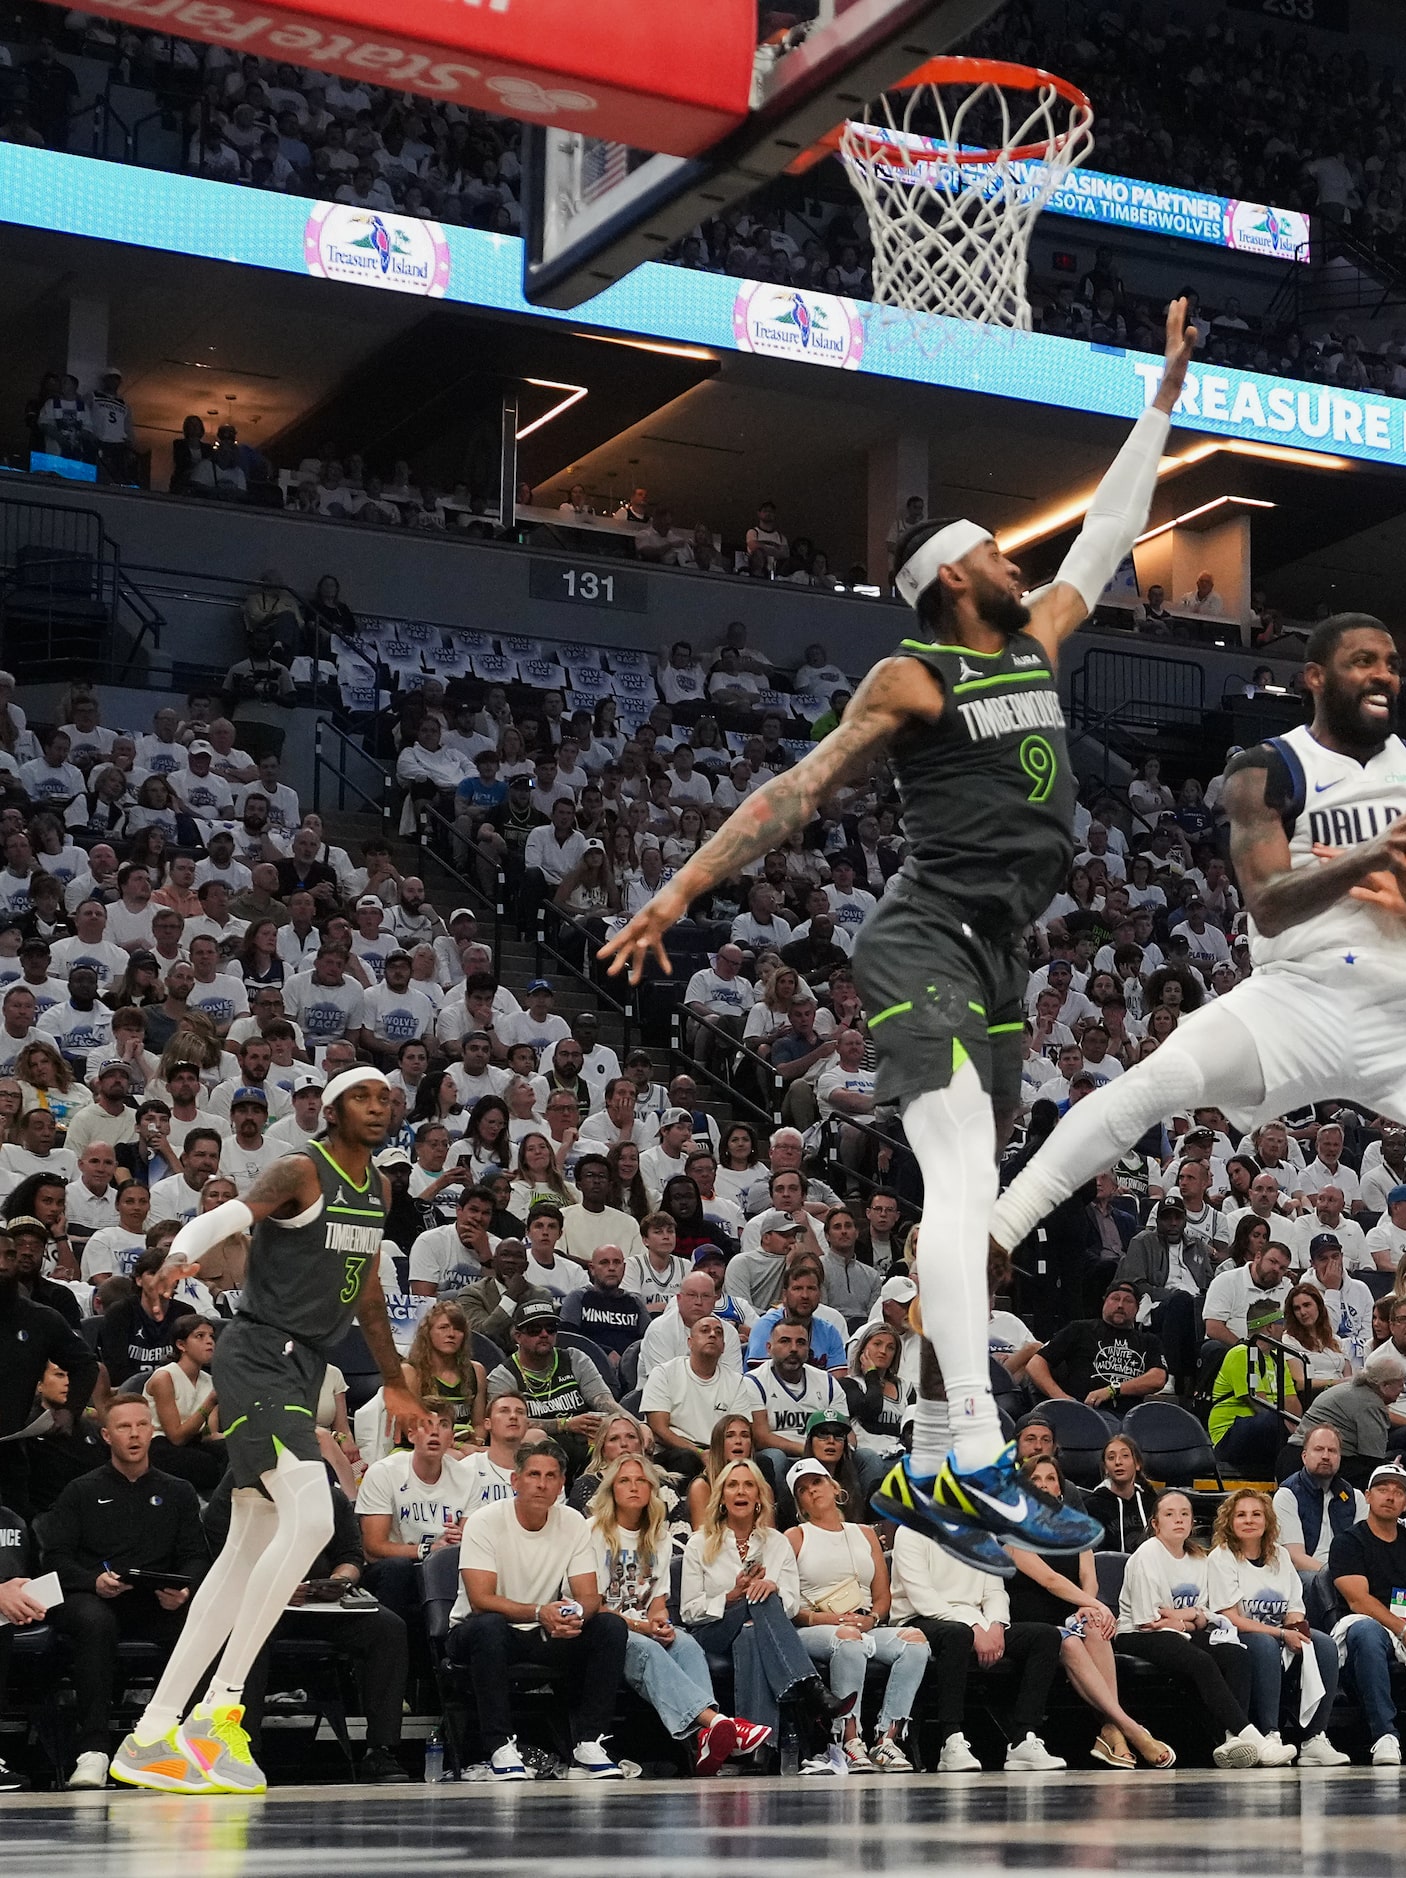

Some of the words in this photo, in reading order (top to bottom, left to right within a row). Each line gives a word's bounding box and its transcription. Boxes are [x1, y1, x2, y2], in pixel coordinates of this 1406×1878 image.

[116, 0, 266, 43] Far
[1099, 200, 1222, 240] TIMBERWOLVES
[1131, 184, 1222, 220] PARTNER
[1238, 228, 1272, 248] Treasure
[327, 244, 379, 270] Treasure
[391, 256, 429, 280] Island
[752, 319, 800, 345] Treasure
[811, 332, 845, 352] Island
[1134, 362, 1391, 450] TREASURE
[562, 569, 616, 602] 131
[957, 690, 1066, 742] TIMBERWOLVE
[1020, 735, 1057, 802] 9
[305, 1007, 346, 1020] WOLVES
[307, 1017, 339, 1029] BACK
[382, 1014, 419, 1027] WOLVES
[387, 1024, 416, 1037] BACK
[340, 1256, 367, 1304] 3
